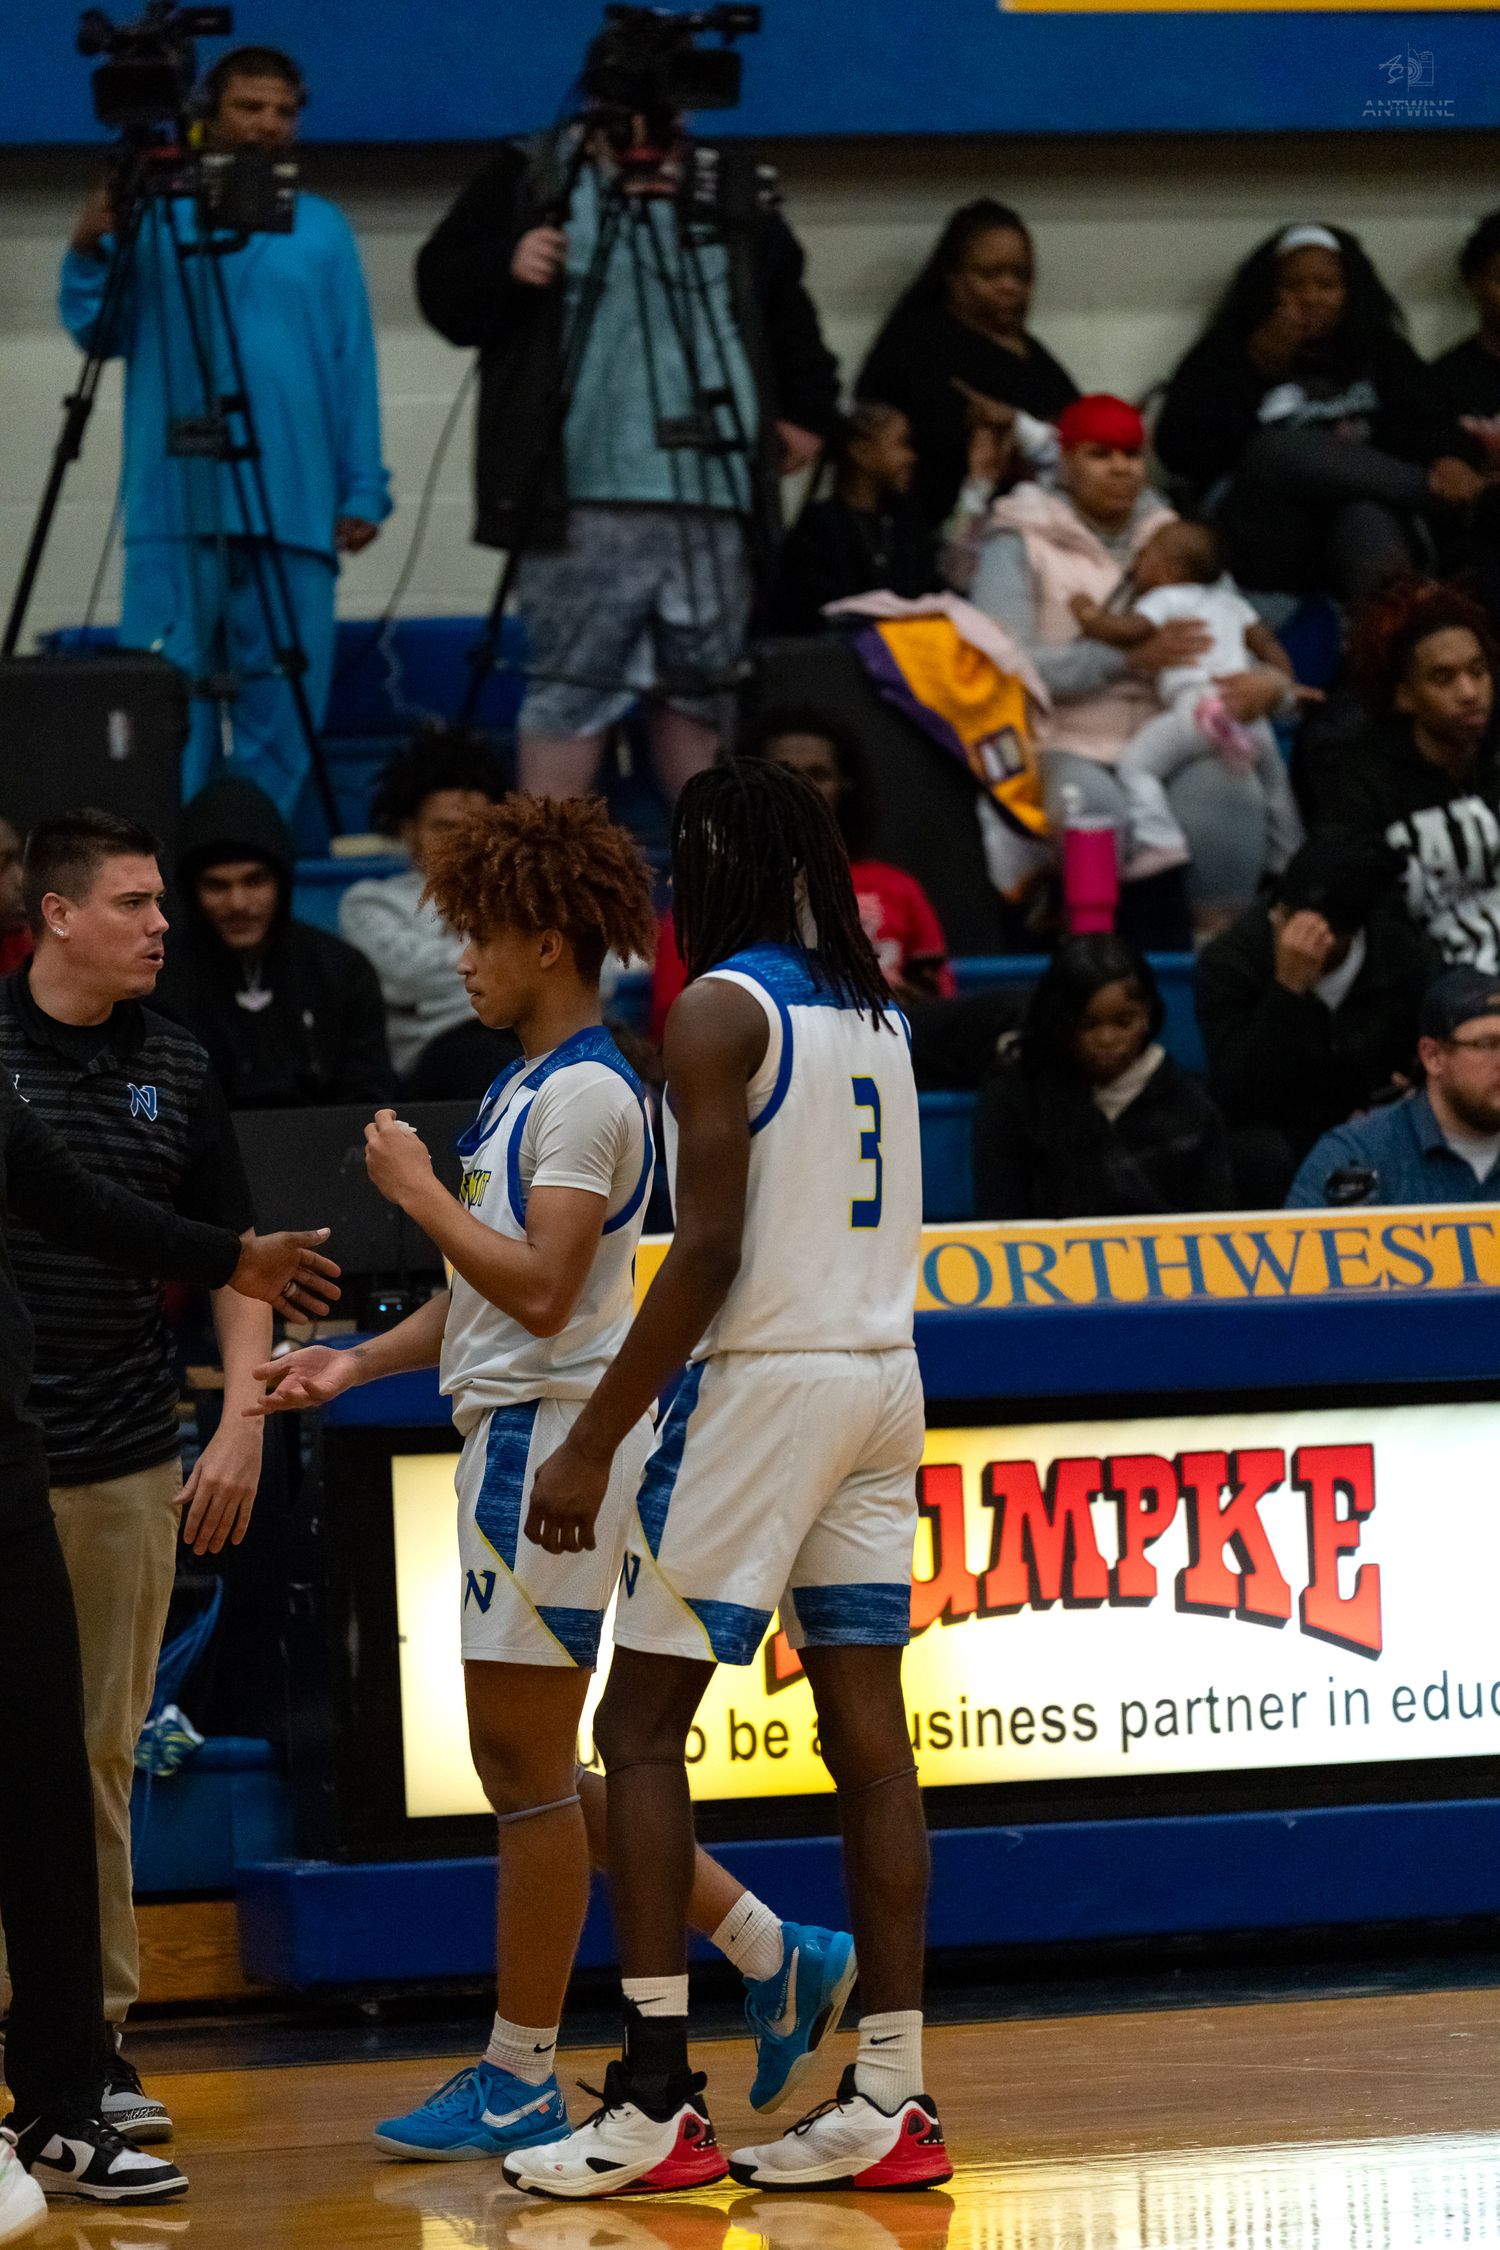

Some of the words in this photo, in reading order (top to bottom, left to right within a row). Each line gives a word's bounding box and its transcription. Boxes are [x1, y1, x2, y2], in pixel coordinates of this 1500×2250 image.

[126, 1082, 158, 1121] N
[849, 1074, 884, 1231] 3
[922, 1219, 1499, 1308] ORTHWEST
[464, 1569, 496, 1614] N
[765, 1443, 1383, 1696] UMPKE
[729, 1708, 789, 1761] be
[911, 1695, 1098, 1752] siness
[1120, 1686, 1307, 1753] partner
[1328, 1676, 1370, 1727] in
